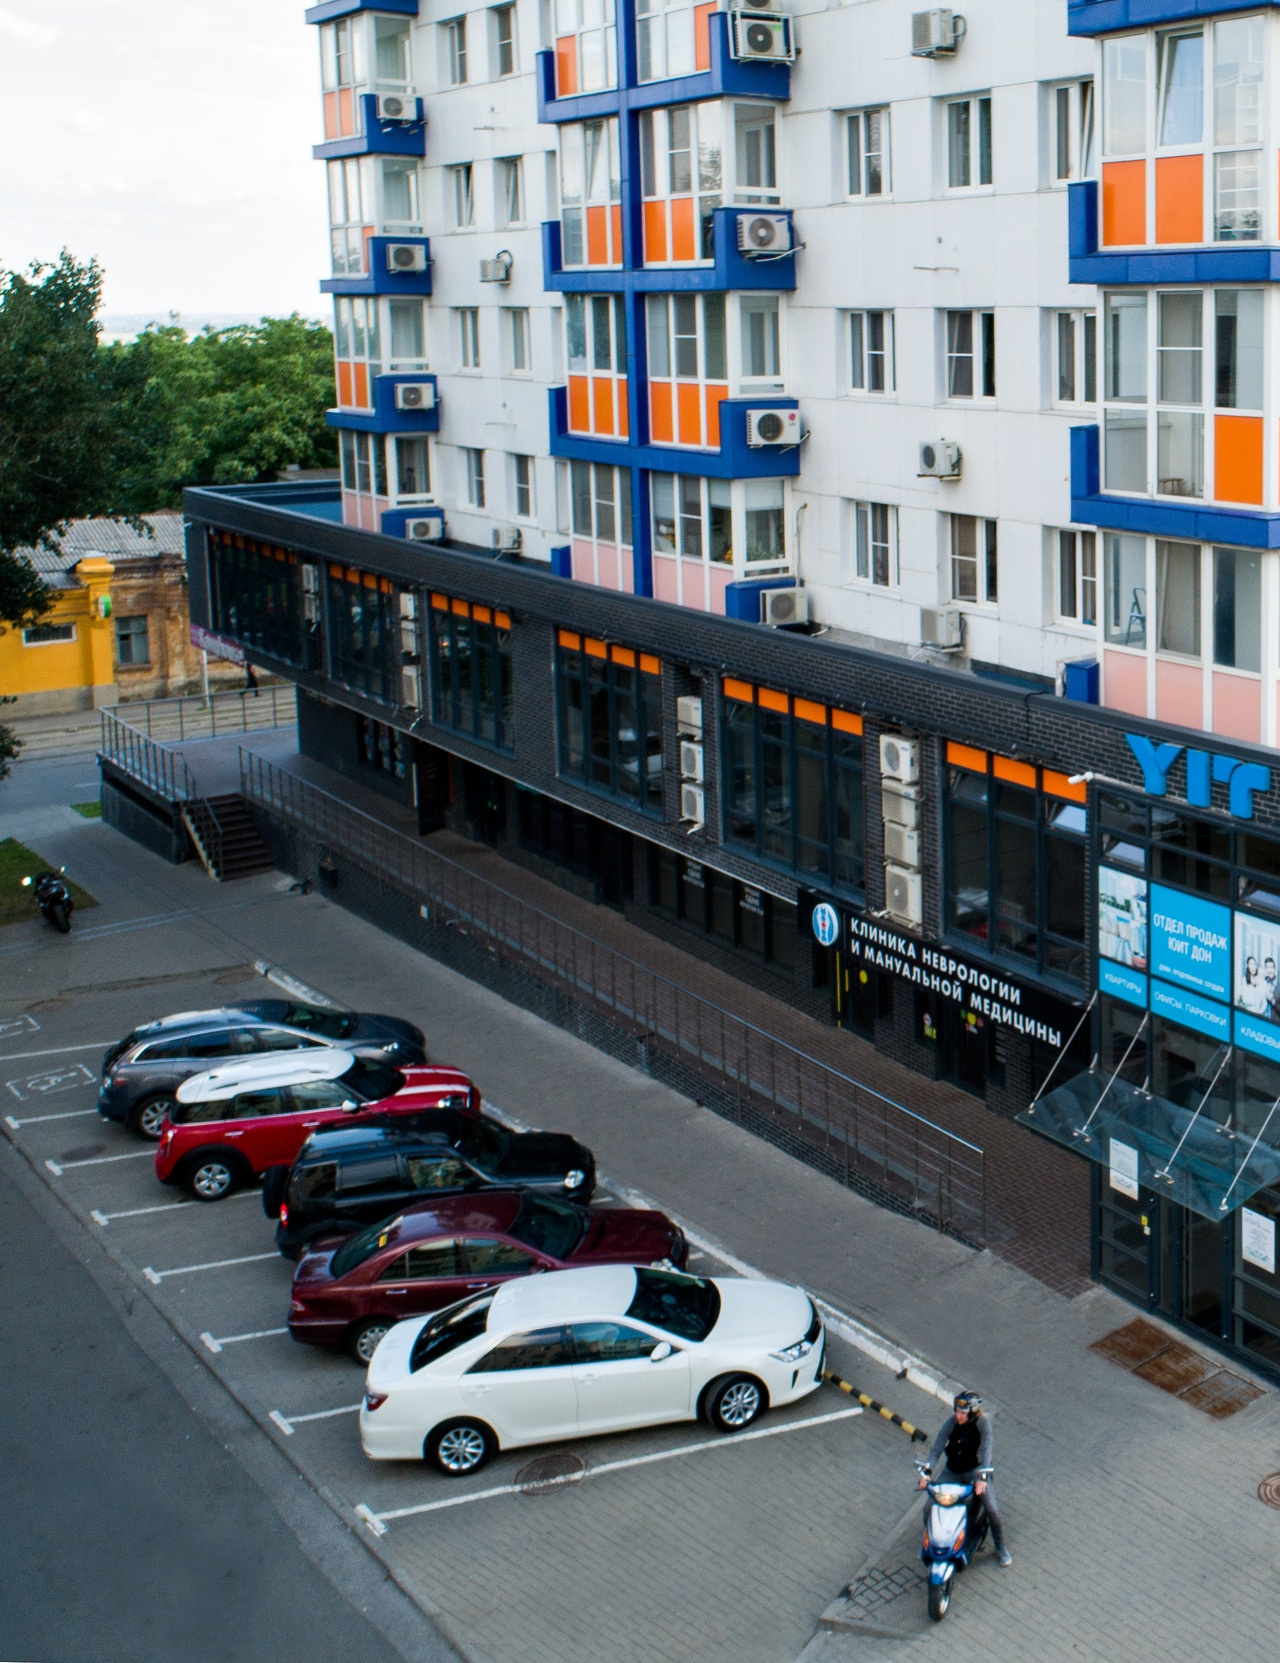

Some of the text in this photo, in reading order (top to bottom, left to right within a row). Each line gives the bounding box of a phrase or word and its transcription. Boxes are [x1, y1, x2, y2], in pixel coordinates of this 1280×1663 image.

[1126, 733, 1271, 819] YIT
[1153, 912, 1228, 950] ОТДЕЛ ПРОДАЖ
[851, 917, 1021, 1006] КЛИНИКА НЕВРОЛОГИИ
[1168, 937, 1212, 964] ЮИТ ДОН
[851, 939, 1062, 1048] И МАНУАЛЬНОЙ МЕДИЦИНЫ
[1105, 972, 1142, 994] КВАРТИРЫ
[1185, 1003, 1227, 1027] ПАРКОВКИ
